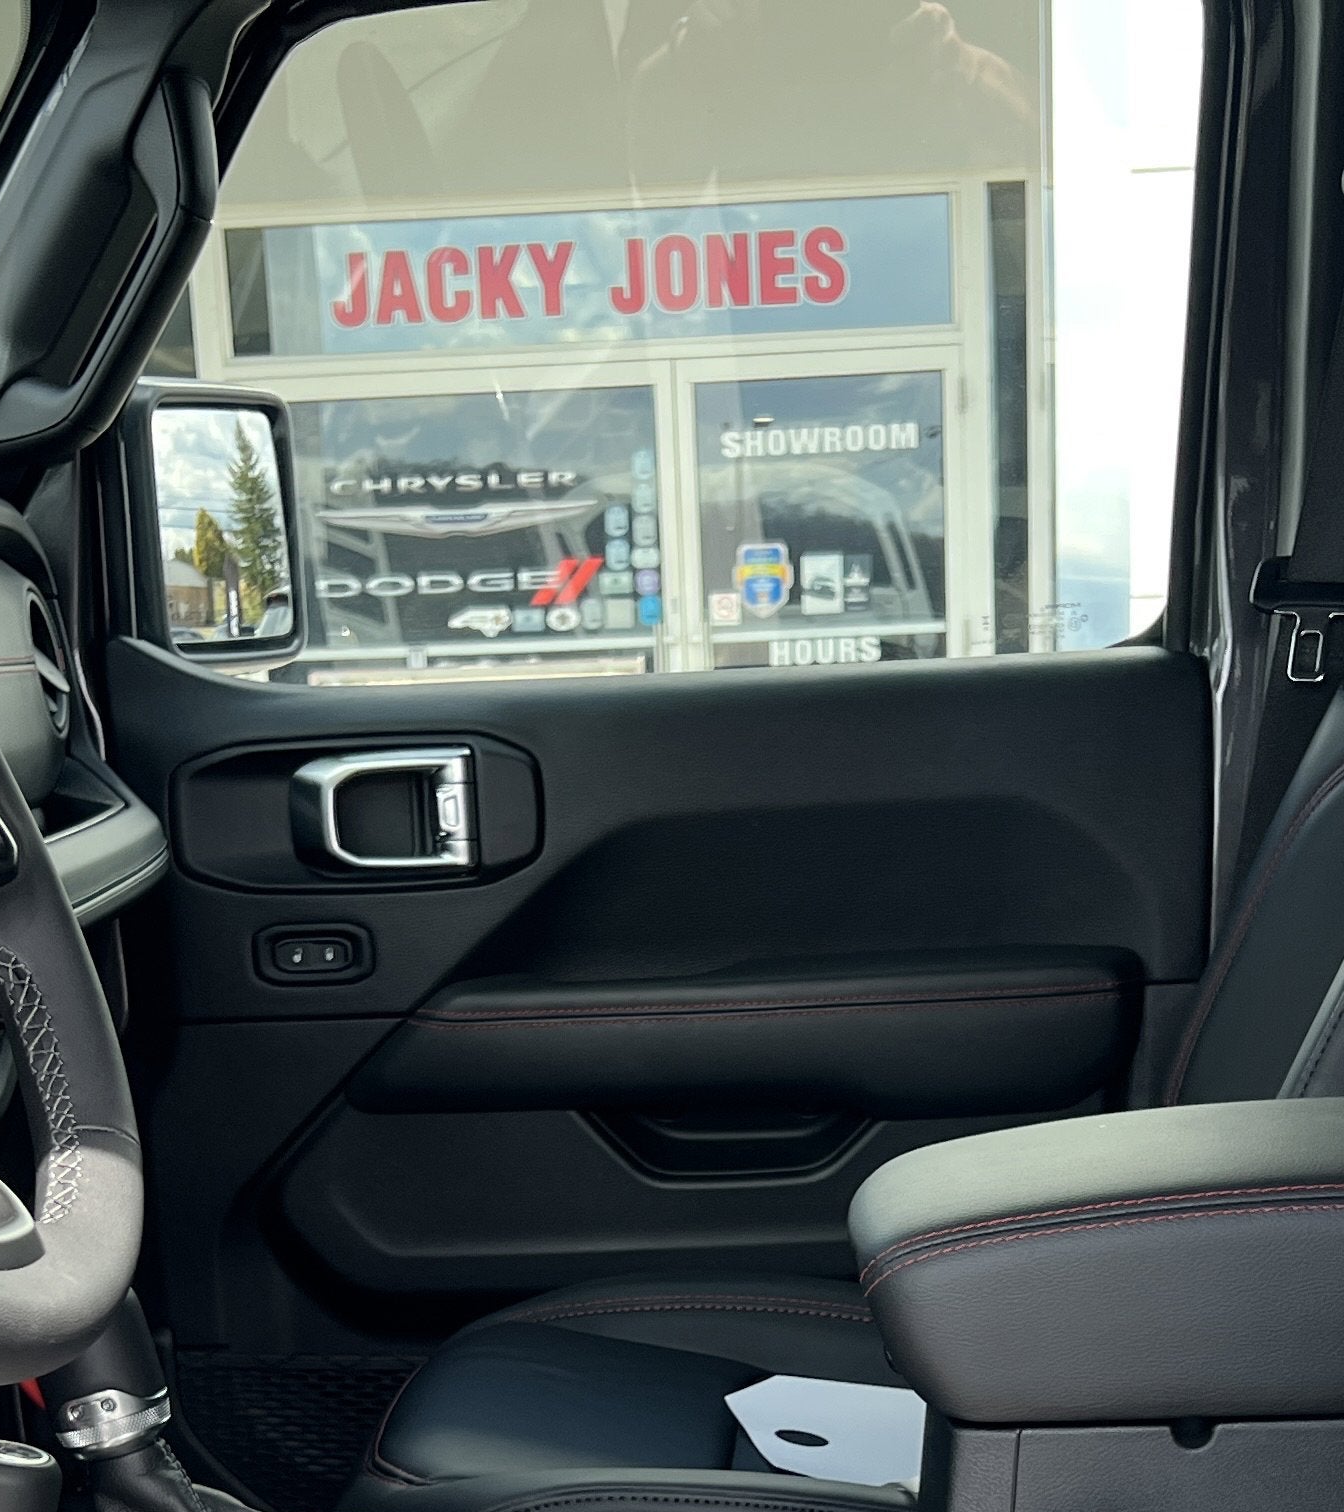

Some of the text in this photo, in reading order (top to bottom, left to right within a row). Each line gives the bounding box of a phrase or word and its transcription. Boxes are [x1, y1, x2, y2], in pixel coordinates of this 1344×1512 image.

[332, 225, 850, 328] JACKY JONES
[720, 422, 919, 458] SHOWROOM
[330, 471, 577, 495] CHRYSLER
[315, 570, 562, 598] DODGE
[768, 635, 882, 667] HOURS
